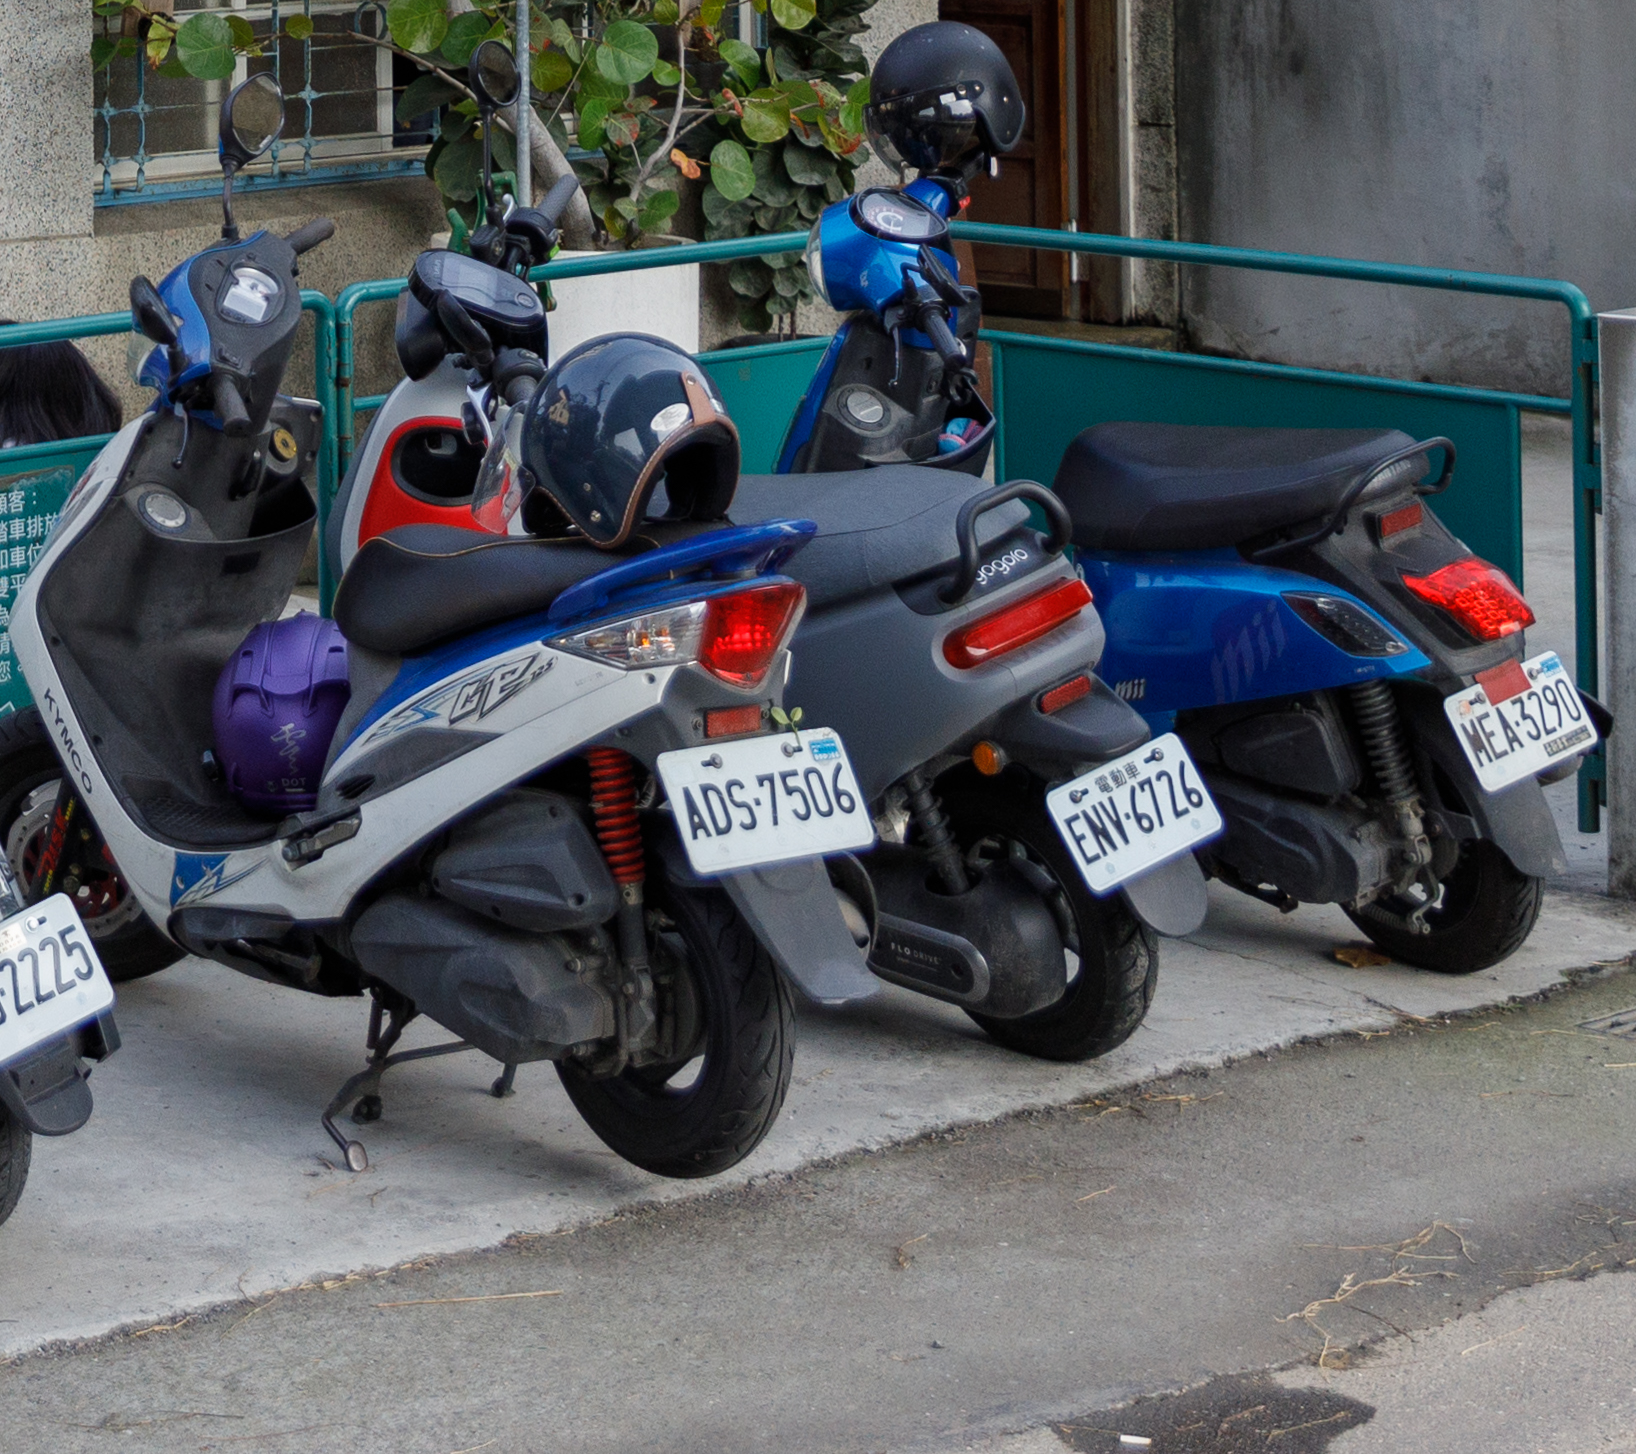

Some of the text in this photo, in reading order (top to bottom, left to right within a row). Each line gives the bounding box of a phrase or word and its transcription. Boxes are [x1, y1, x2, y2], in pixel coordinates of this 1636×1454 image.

[44, 687, 92, 794] KYMCO
[1460, 678, 1581, 767] MEA-3290
[282, 778, 306, 786] DOT
[683, 762, 856, 840] ADS-7506
[1063, 759, 1203, 865] ENV-6726
[1094, 761, 1140, 793] 電動車
[890, 942, 911, 955] FLO
